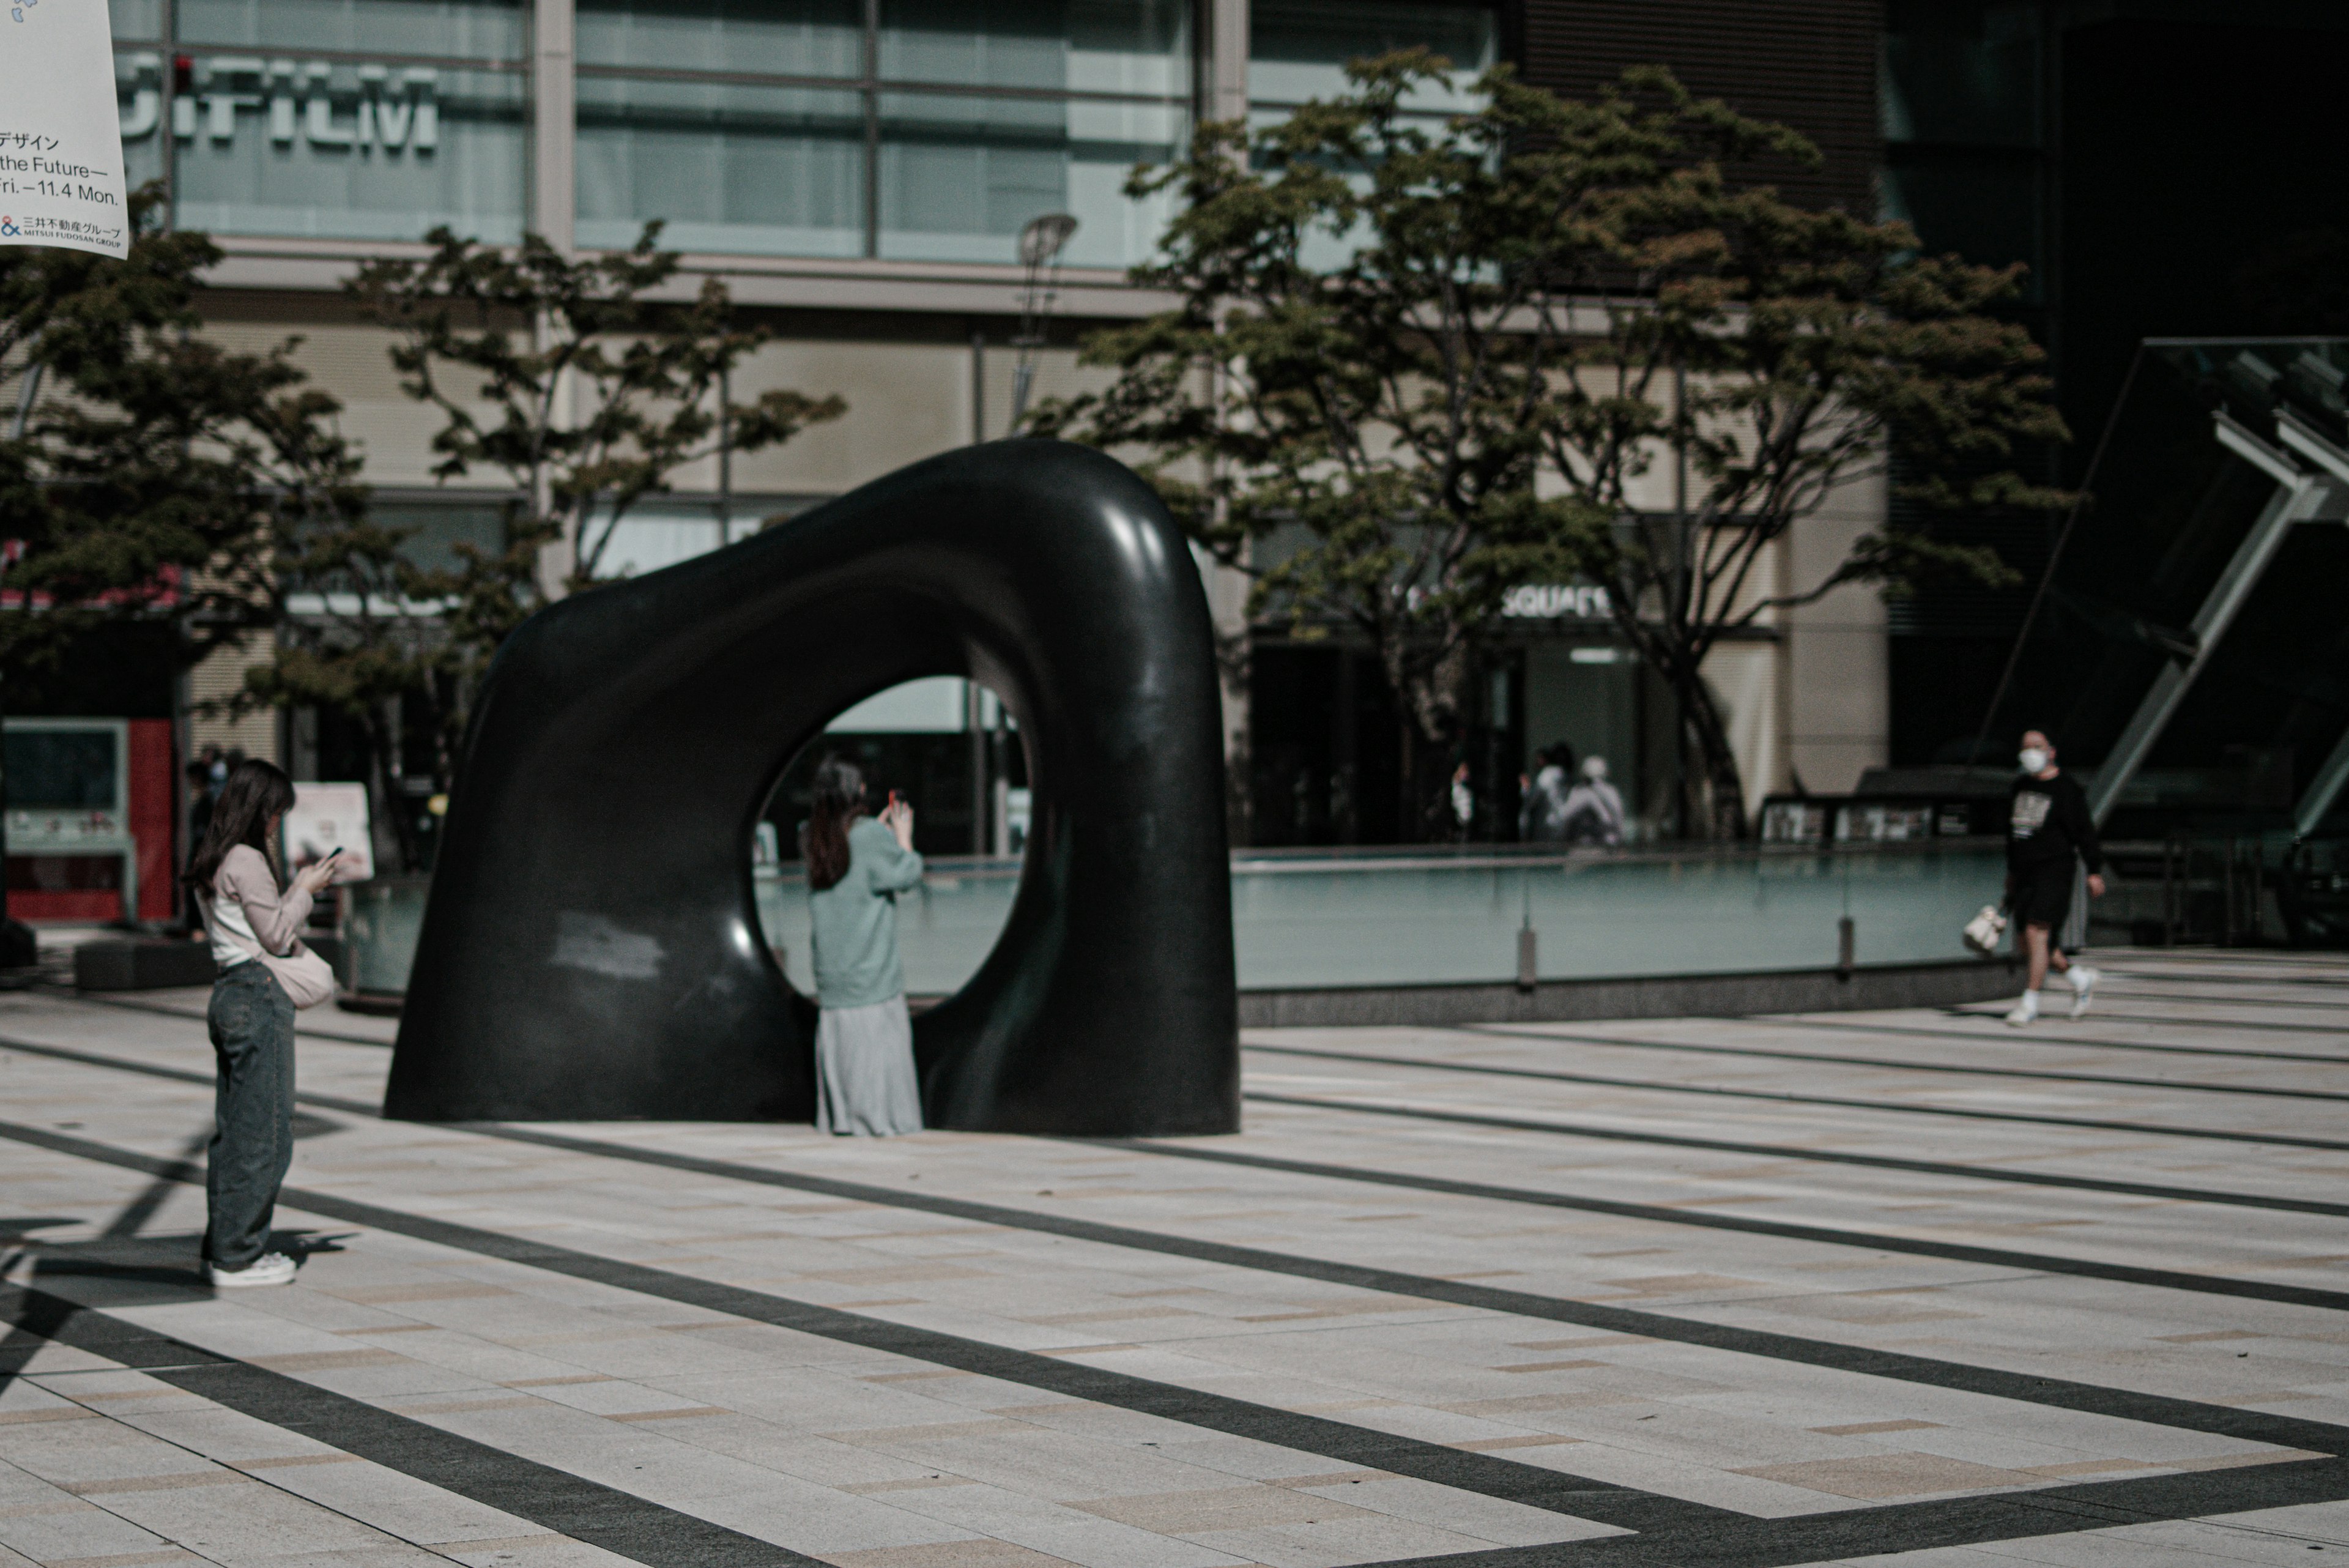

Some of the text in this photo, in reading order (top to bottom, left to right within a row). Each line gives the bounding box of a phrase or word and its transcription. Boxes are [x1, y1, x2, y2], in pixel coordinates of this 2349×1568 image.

[0, 155, 28, 171] the
[78, 185, 117, 206] Mon.
[23, 217, 121, 239] 三井不動産グループ
[56, 231, 94, 243] FUDOSAN
[96, 239, 121, 248] GROUP
